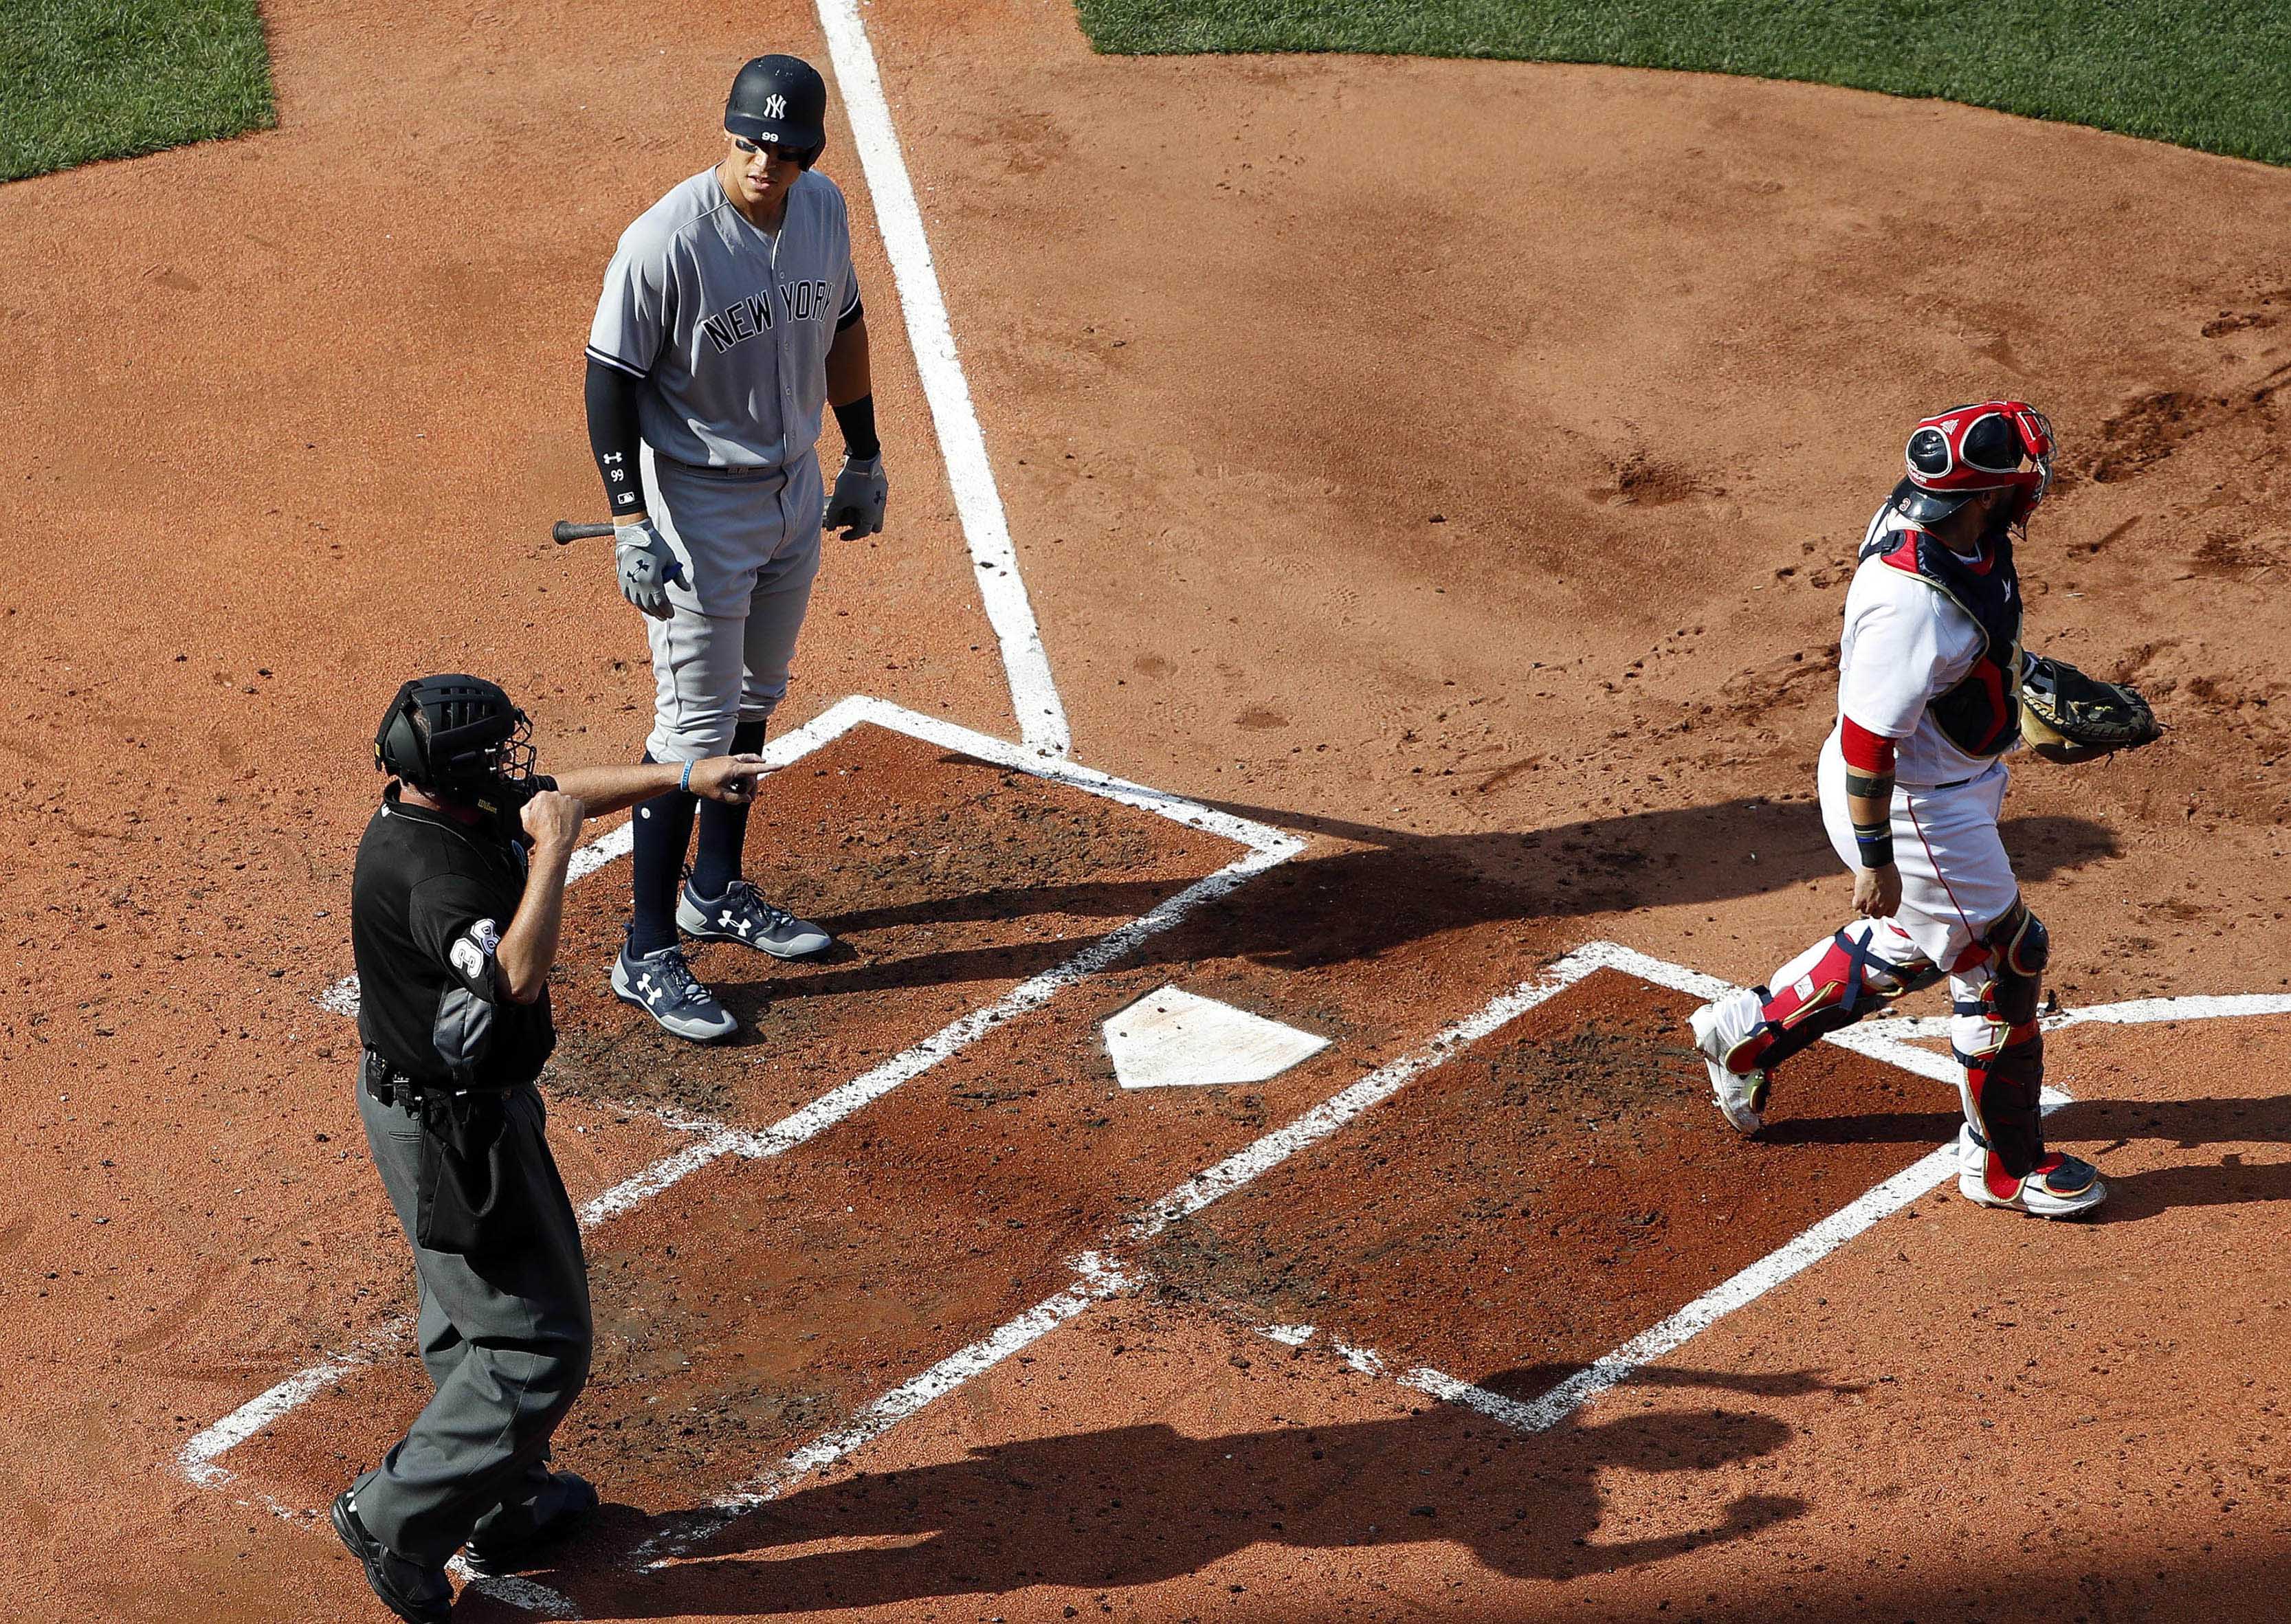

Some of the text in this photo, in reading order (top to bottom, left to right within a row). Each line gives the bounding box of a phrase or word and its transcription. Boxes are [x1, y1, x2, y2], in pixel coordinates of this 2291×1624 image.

[763, 93, 787, 120] NY
[761, 131, 779, 142] 99
[700, 289, 774, 354] NEW
[610, 469, 624, 482] 99
[1899, 497, 1911, 511] 3
[478, 799, 497, 814] Wilson
[450, 918, 500, 979] 38
